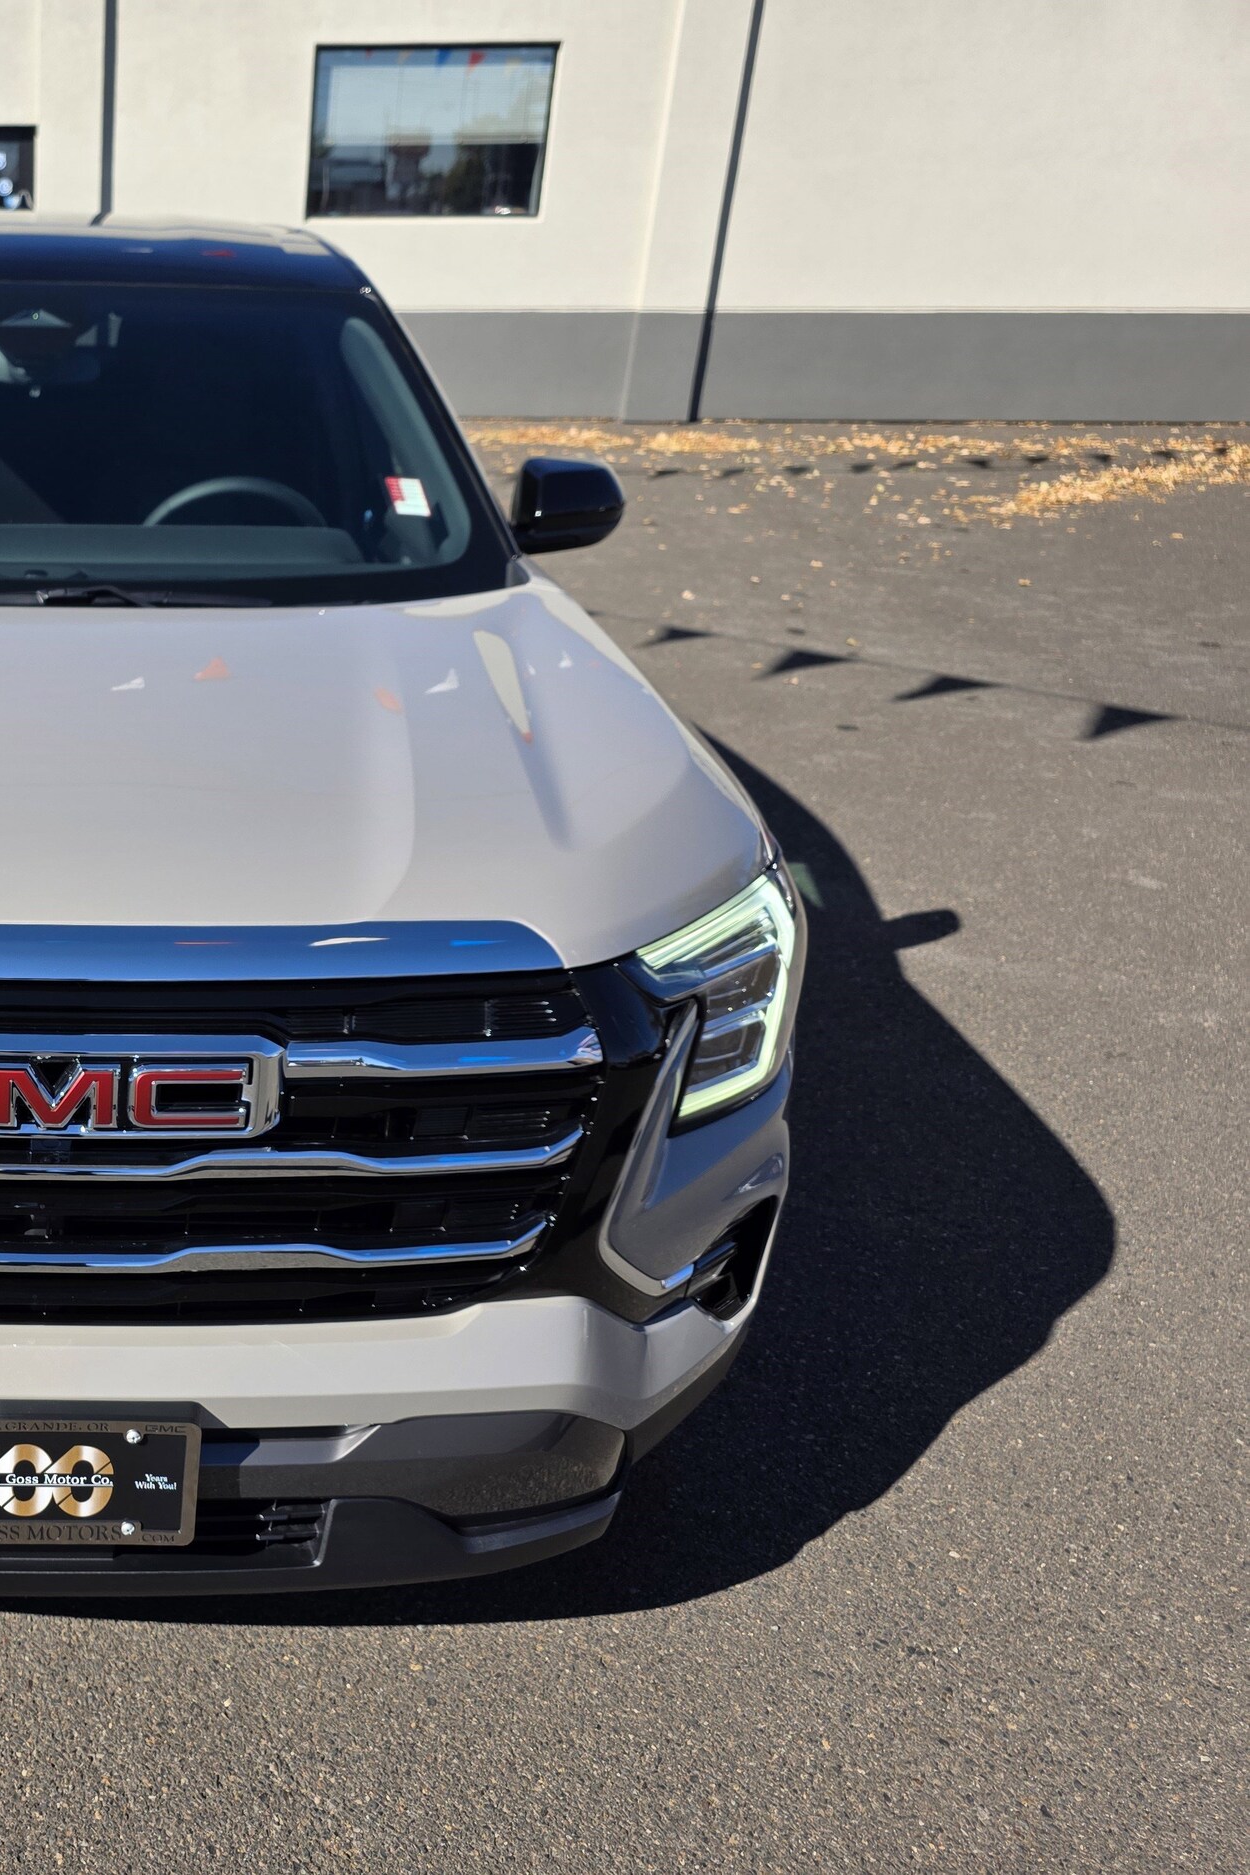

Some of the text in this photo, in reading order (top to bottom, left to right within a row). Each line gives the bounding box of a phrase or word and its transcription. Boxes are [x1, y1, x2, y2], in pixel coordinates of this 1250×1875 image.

[145, 1424, 187, 1433] GMC
[5, 1474, 39, 1485] Goss
[43, 1473, 87, 1485] Motor
[91, 1474, 114, 1485] Co.
[144, 1473, 168, 1482] Years
[134, 1480, 177, 1490] With You!
[26, 1524, 123, 1542] MOTORS
